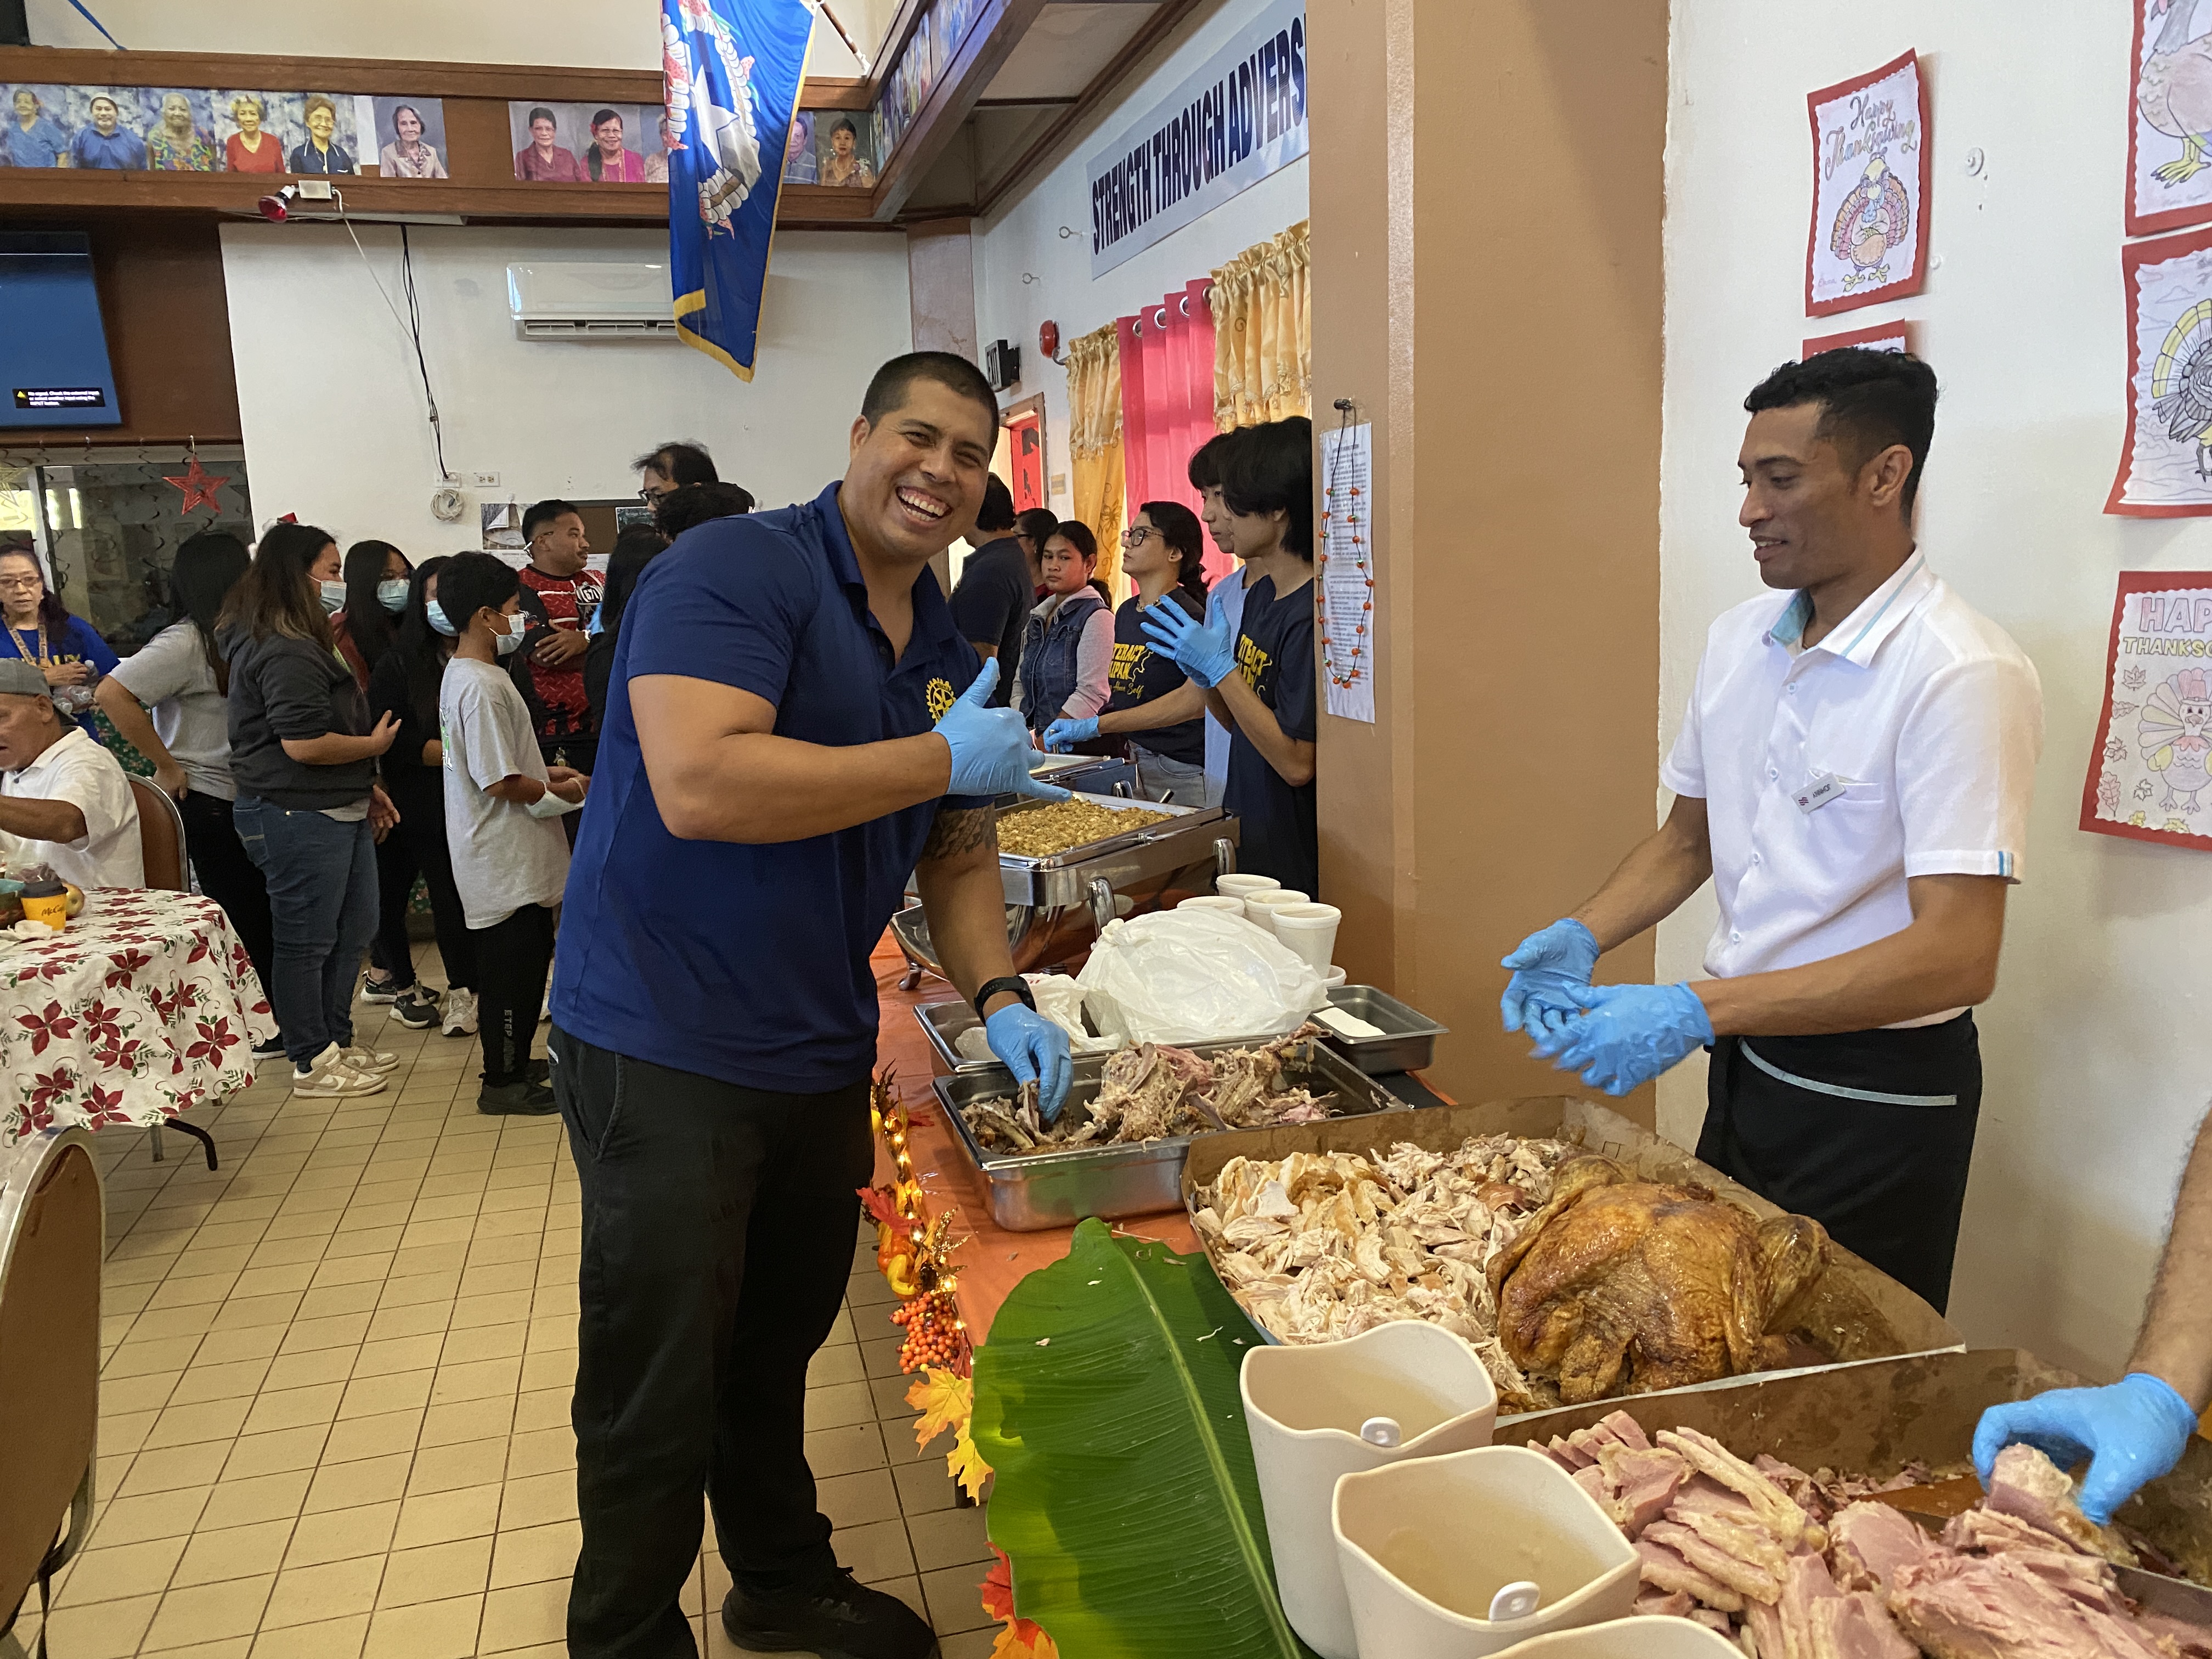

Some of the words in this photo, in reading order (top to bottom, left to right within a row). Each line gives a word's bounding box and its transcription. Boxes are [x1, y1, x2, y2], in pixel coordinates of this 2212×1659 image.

[1849, 93, 1896, 131] Happy
[1092, 139, 1152, 256] STRENGTH
[1153, 80, 1225, 215] THROUGH
[1825, 120, 1918, 182] Thanksgiving
[1112, 643, 1146, 662] TERACT
